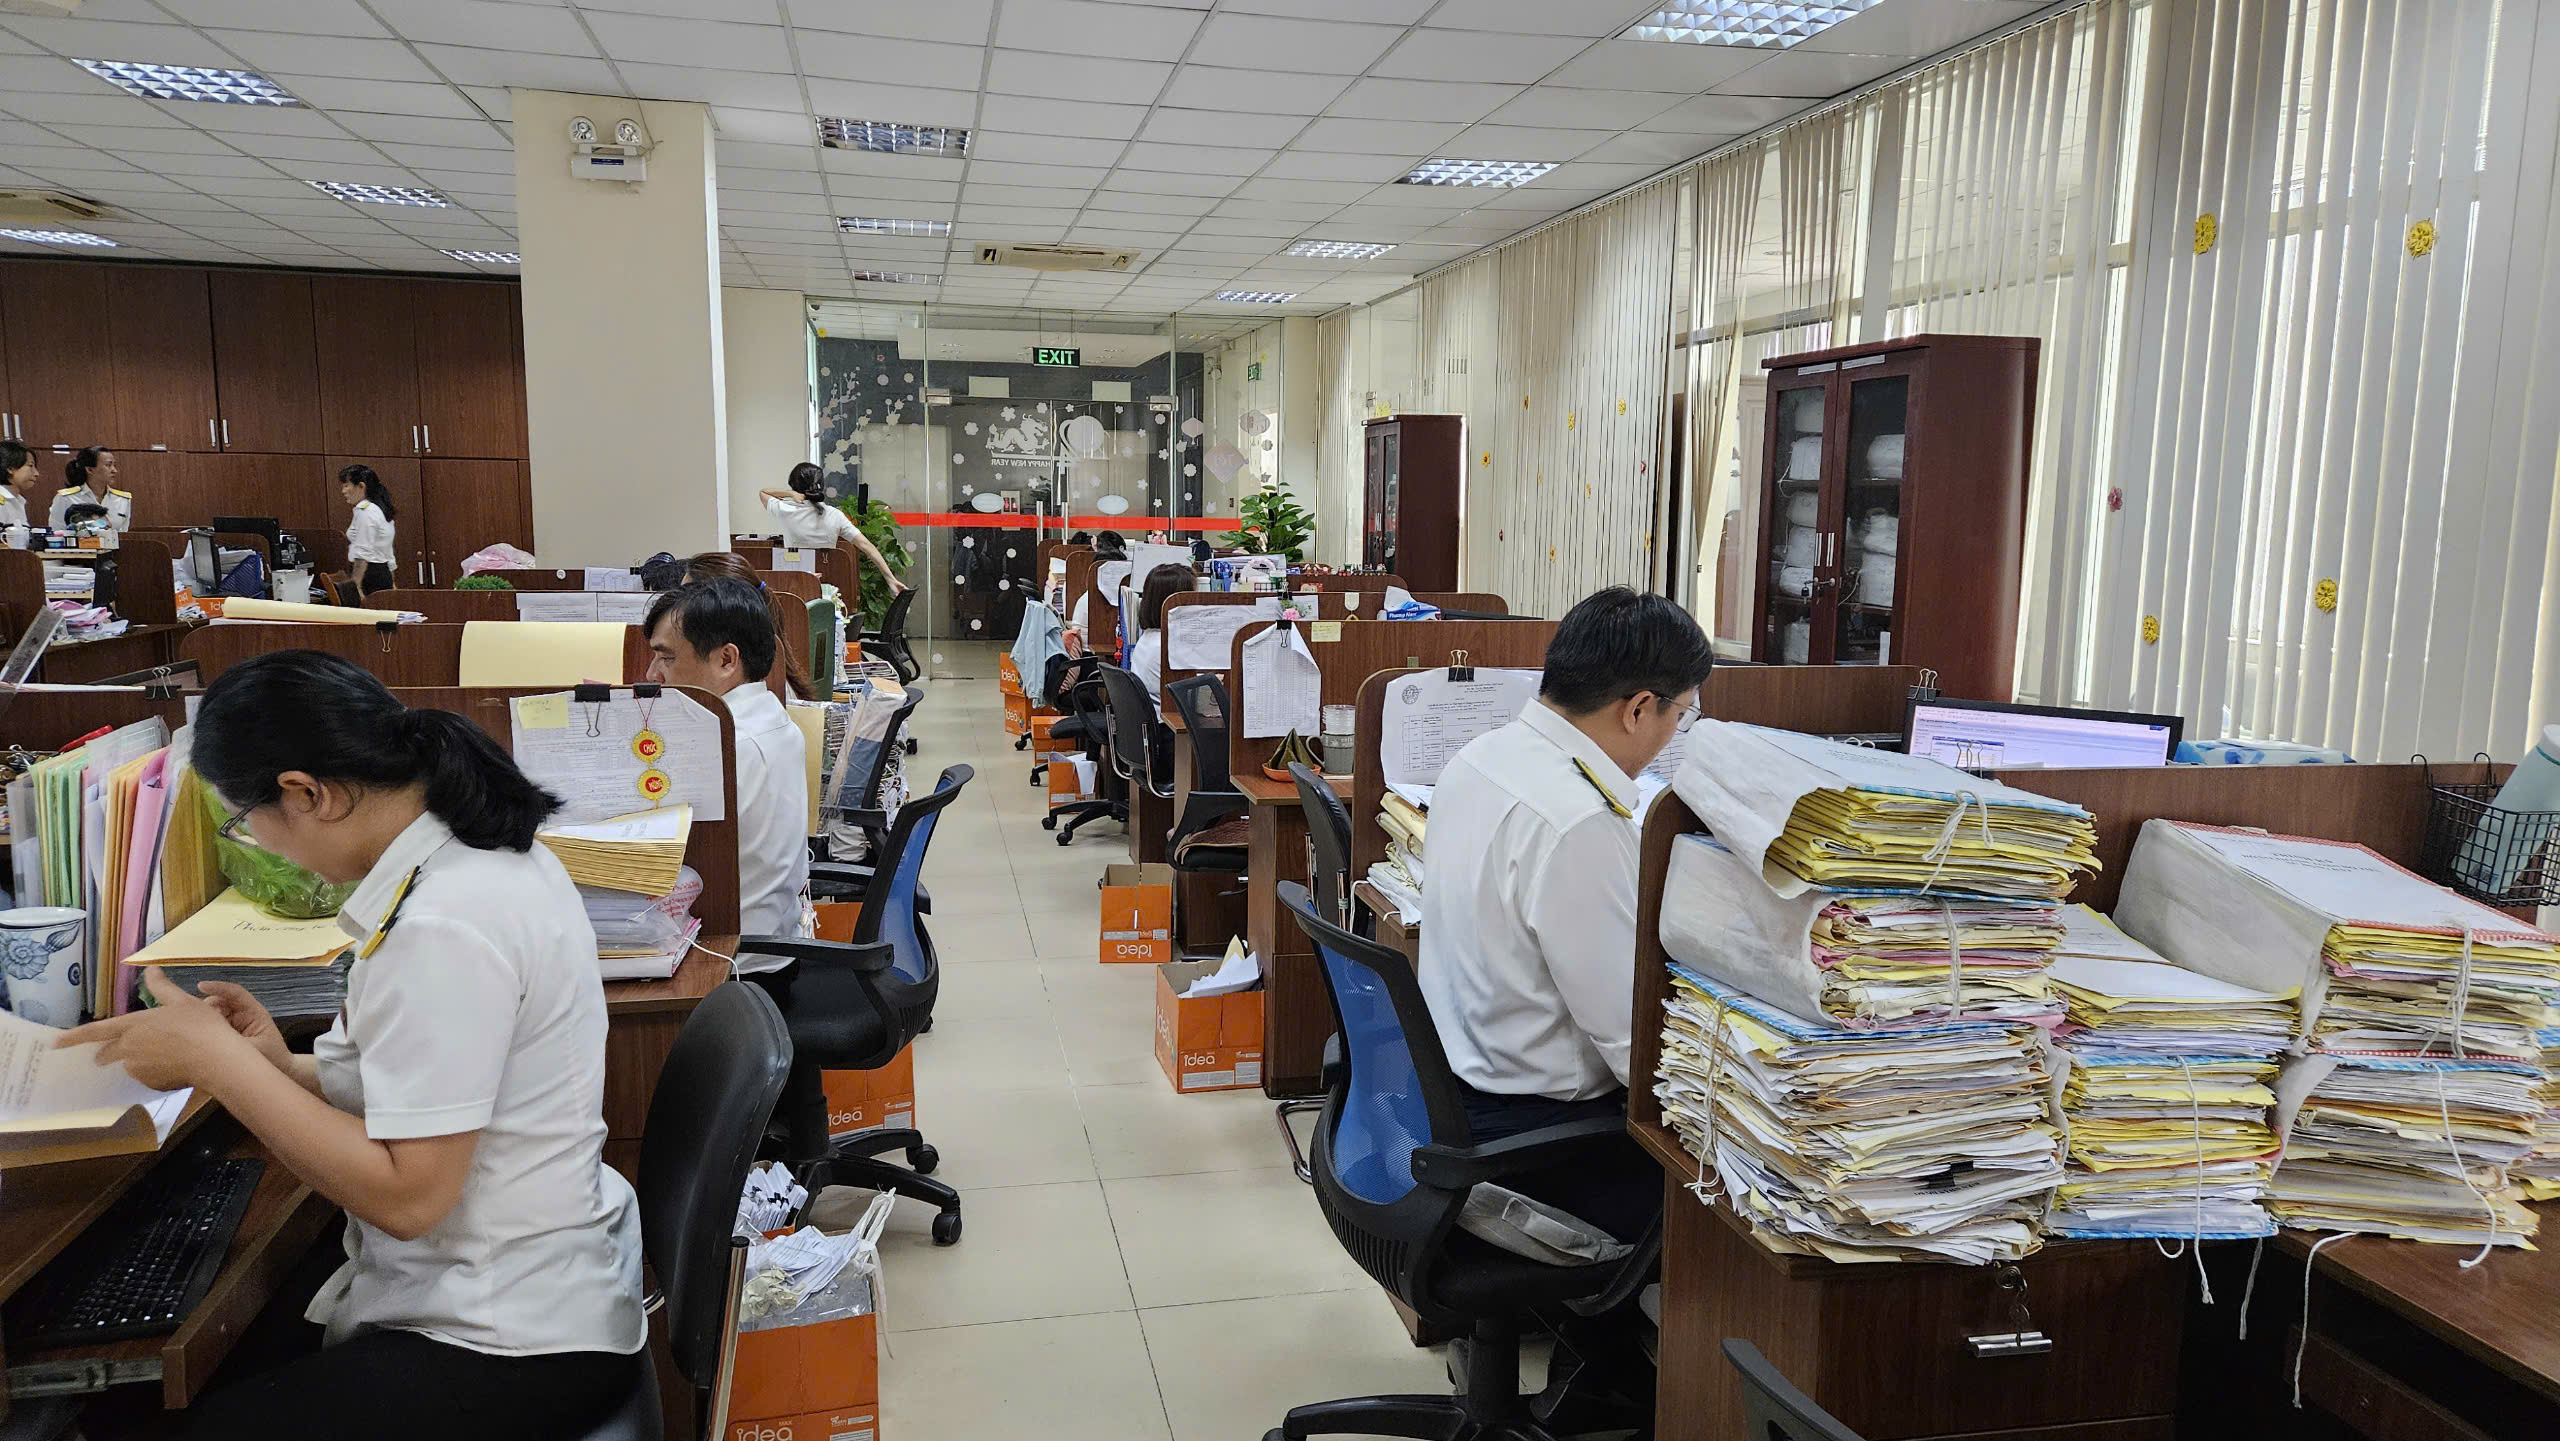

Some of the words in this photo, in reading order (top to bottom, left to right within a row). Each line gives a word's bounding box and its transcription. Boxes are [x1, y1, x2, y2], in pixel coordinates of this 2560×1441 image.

[1038, 349, 1075, 365] EXIT
[1117, 944, 1152, 959] idea
[1184, 1053, 1216, 1067] idea
[828, 1110, 863, 1127] idea
[736, 1424, 793, 1441] idea
